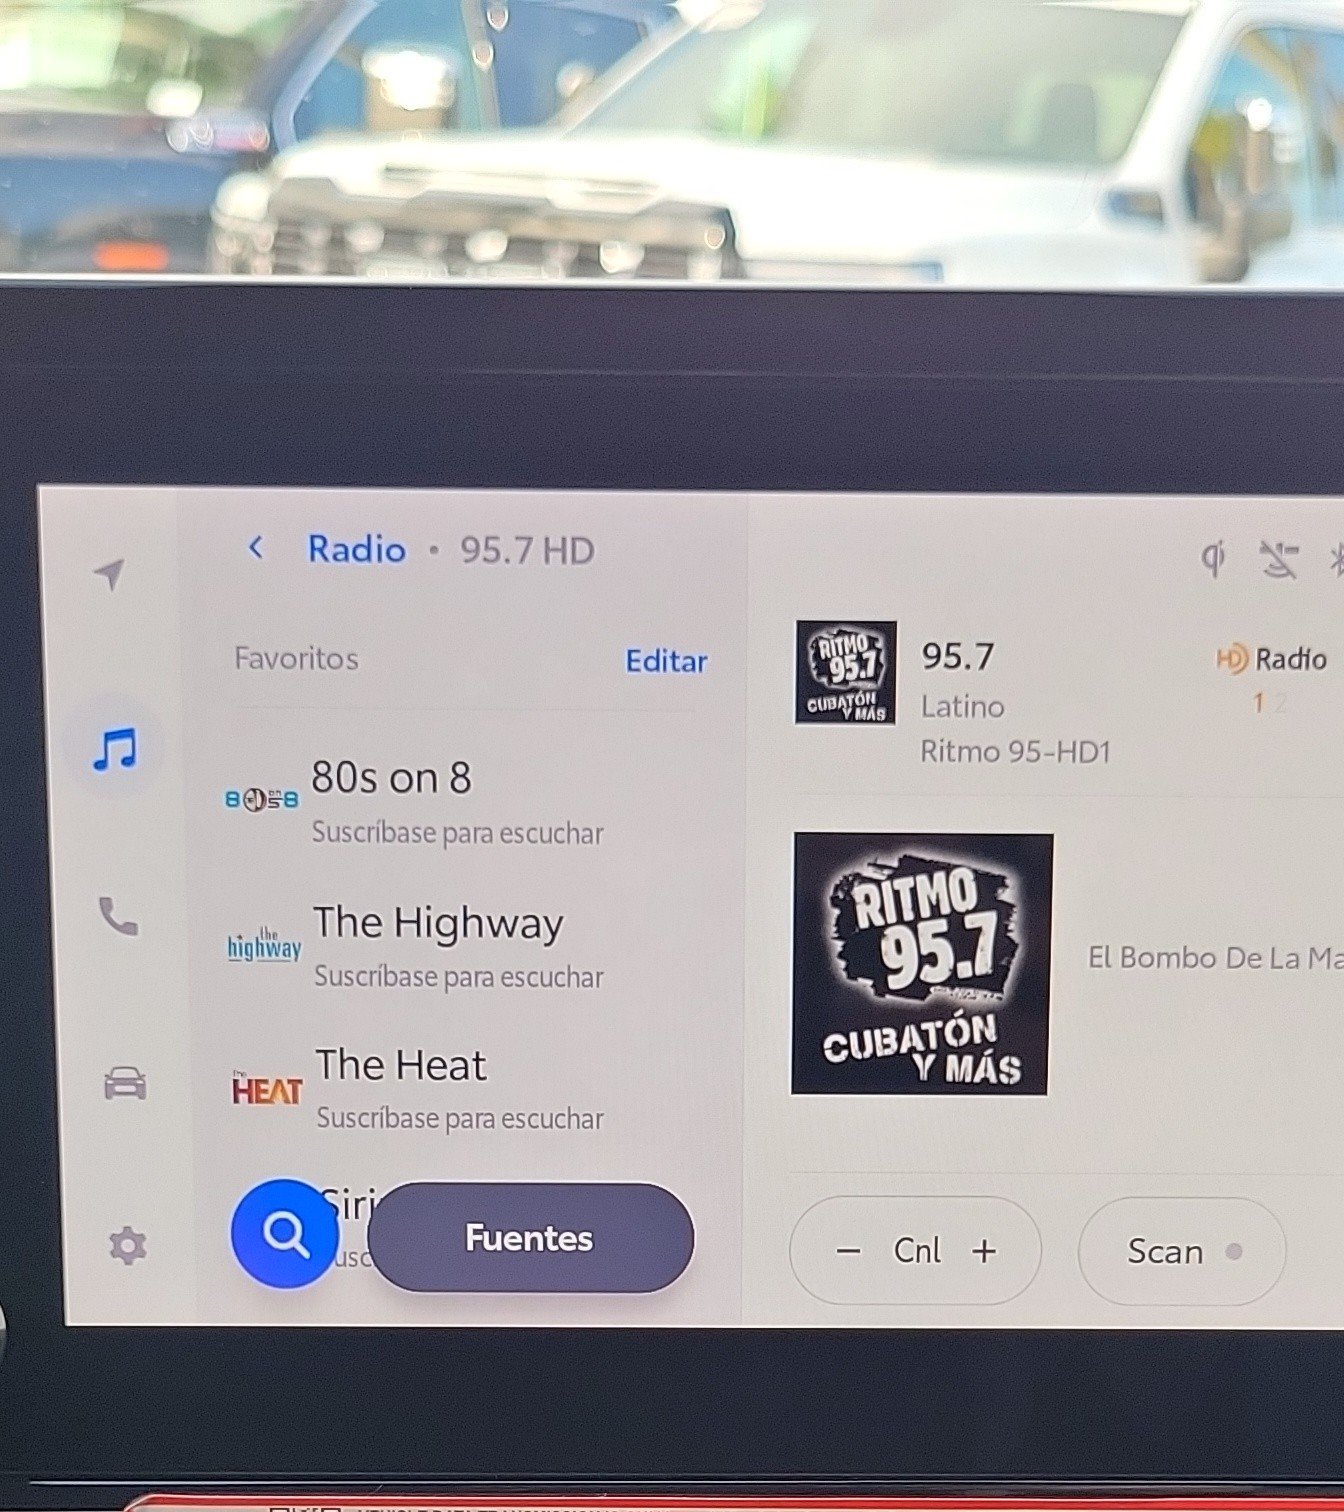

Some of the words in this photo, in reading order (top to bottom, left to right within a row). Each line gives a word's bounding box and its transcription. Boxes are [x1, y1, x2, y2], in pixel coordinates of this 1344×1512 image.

[308, 534, 407, 564] Radio
[461, 536, 534, 566] 95.7
[543, 537, 596, 566] HD
[235, 645, 360, 672] Favoritos
[626, 648, 708, 674] Editar
[818, 633, 869, 660] RITMO
[921, 642, 996, 672] 95.7
[1256, 645, 1328, 672] Radio
[829, 648, 877, 684] 95.7
[921, 694, 1005, 720] Latino
[1255, 690, 1264, 714] 1
[920, 739, 1001, 765] Ritmo
[1008, 739, 1111, 765] 95-HD1
[311, 760, 377, 794] 80s
[390, 767, 439, 794] on
[449, 760, 473, 794] 8
[311, 819, 438, 845] Suscríbase
[443, 826, 495, 851] para
[500, 820, 605, 846] escuchar
[851, 866, 978, 930] RITMO
[259, 925, 279, 941] the
[313, 904, 383, 939] The
[395, 904, 565, 948] Highway
[227, 934, 302, 961] highway
[880, 909, 999, 991] 95.7
[1088, 945, 1113, 970] El
[1120, 945, 1217, 970] Bombo
[1226, 945, 1262, 970] De
[1270, 945, 1301, 970] La
[314, 963, 439, 989] Suscríbase
[443, 969, 496, 994] para
[500, 964, 605, 990] escuchar
[822, 1008, 998, 1064] CUBATÓN
[316, 1047, 385, 1081] The
[396, 1048, 488, 1082] Heat
[912, 1052, 937, 1082] Y
[945, 1048, 1022, 1085] MÁS
[232, 1078, 304, 1105] HEAT
[316, 1105, 440, 1130] Suscríbase
[445, 1111, 497, 1135] para
[500, 1106, 605, 1131] escuchar
[464, 1223, 594, 1252] Fuentes
[893, 1235, 942, 1264] Cnl
[1127, 1238, 1204, 1265] Scan
